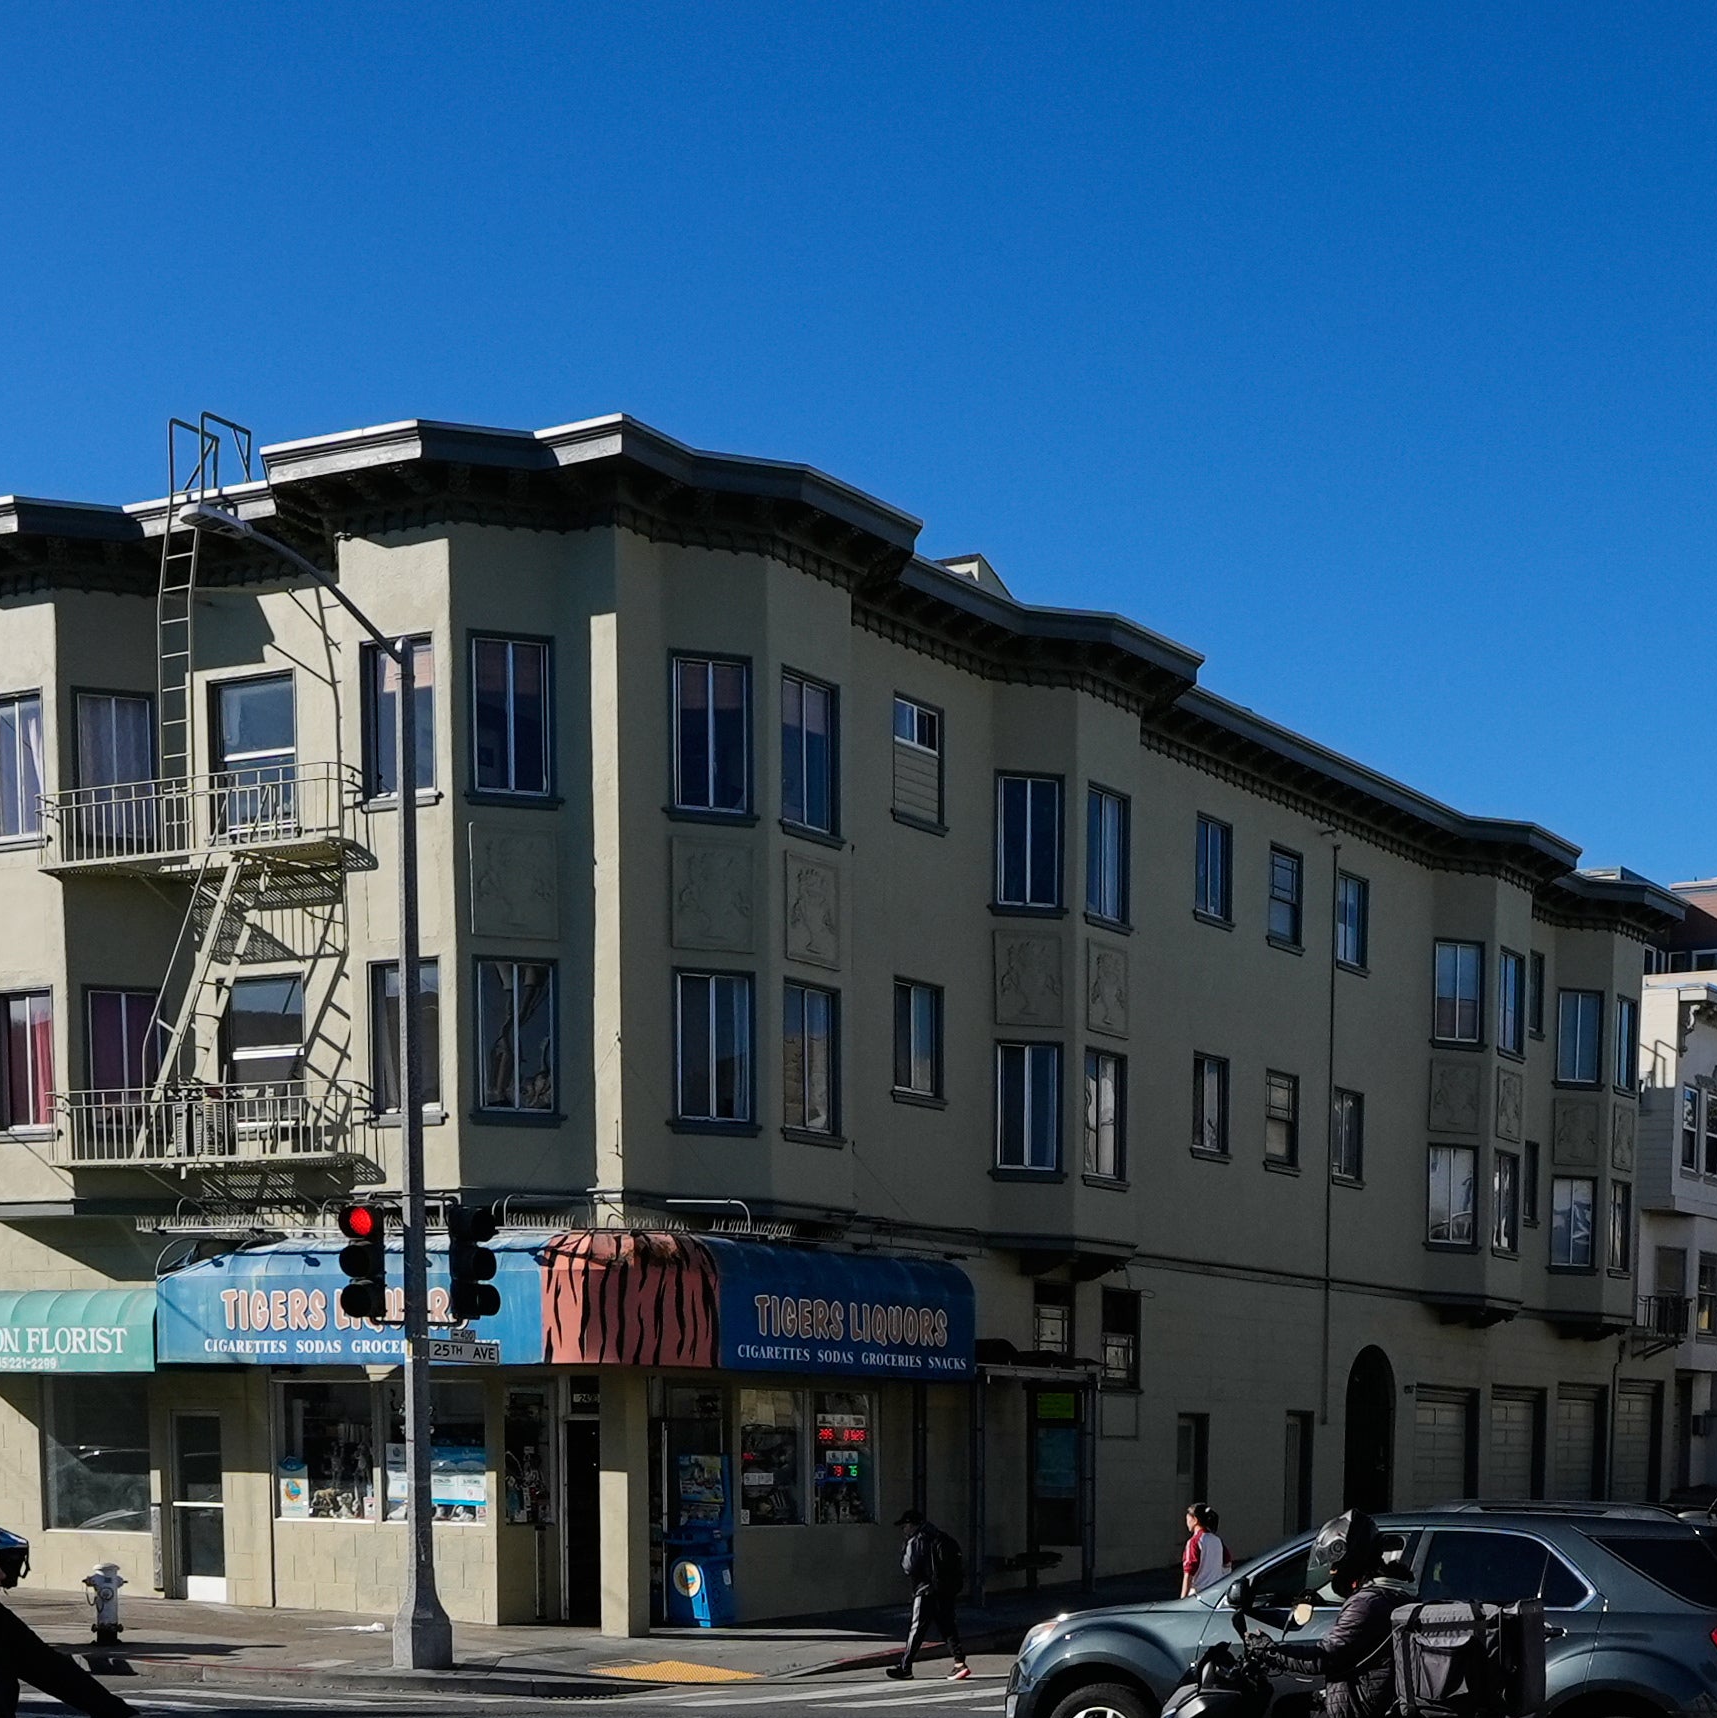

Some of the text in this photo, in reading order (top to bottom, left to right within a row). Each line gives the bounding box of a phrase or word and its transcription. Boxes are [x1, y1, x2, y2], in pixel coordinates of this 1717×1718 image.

[220, 1287, 328, 1331] TIGERS
[754, 1294, 948, 1348] TIGERS LIQUORS
[26, 1326, 128, 1355] FLORIST
[204, 1338, 287, 1354] CIGARETTES
[295, 1338, 342, 1354] SODAS
[433, 1344, 463, 1357] 25TH
[472, 1346, 496, 1361] AVE
[737, 1344, 967, 1370] CIGARETTES SODAS GROCERIES SNACKS
